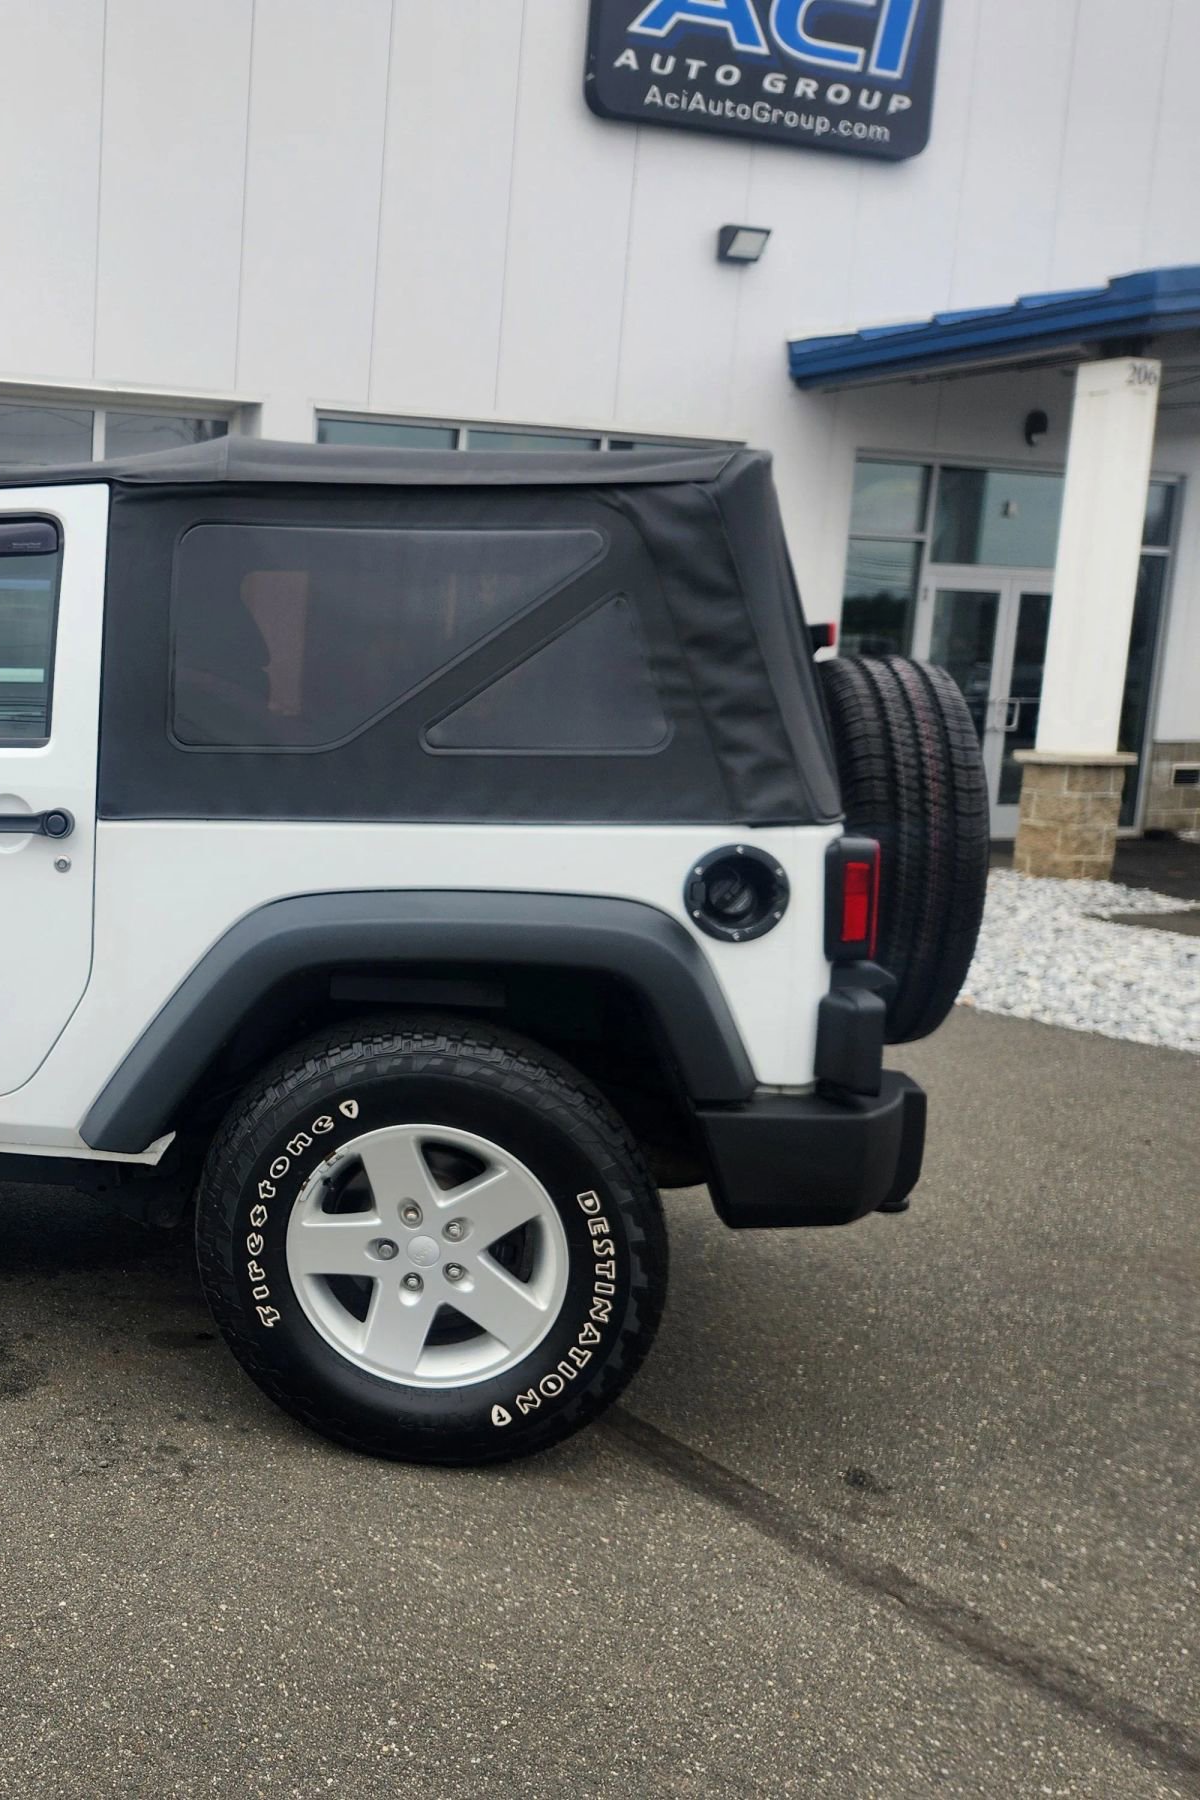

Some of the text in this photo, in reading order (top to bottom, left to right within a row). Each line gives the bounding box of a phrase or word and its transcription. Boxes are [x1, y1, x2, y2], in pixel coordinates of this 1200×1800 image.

[613, 48, 912, 114] AUTO GROUP
[644, 84, 891, 142] AciAutoGroup.com
[1125, 362, 1158, 385] 206
[247, 1116, 334, 1327] Firestone
[516, 1190, 616, 1415] DESTINATION
